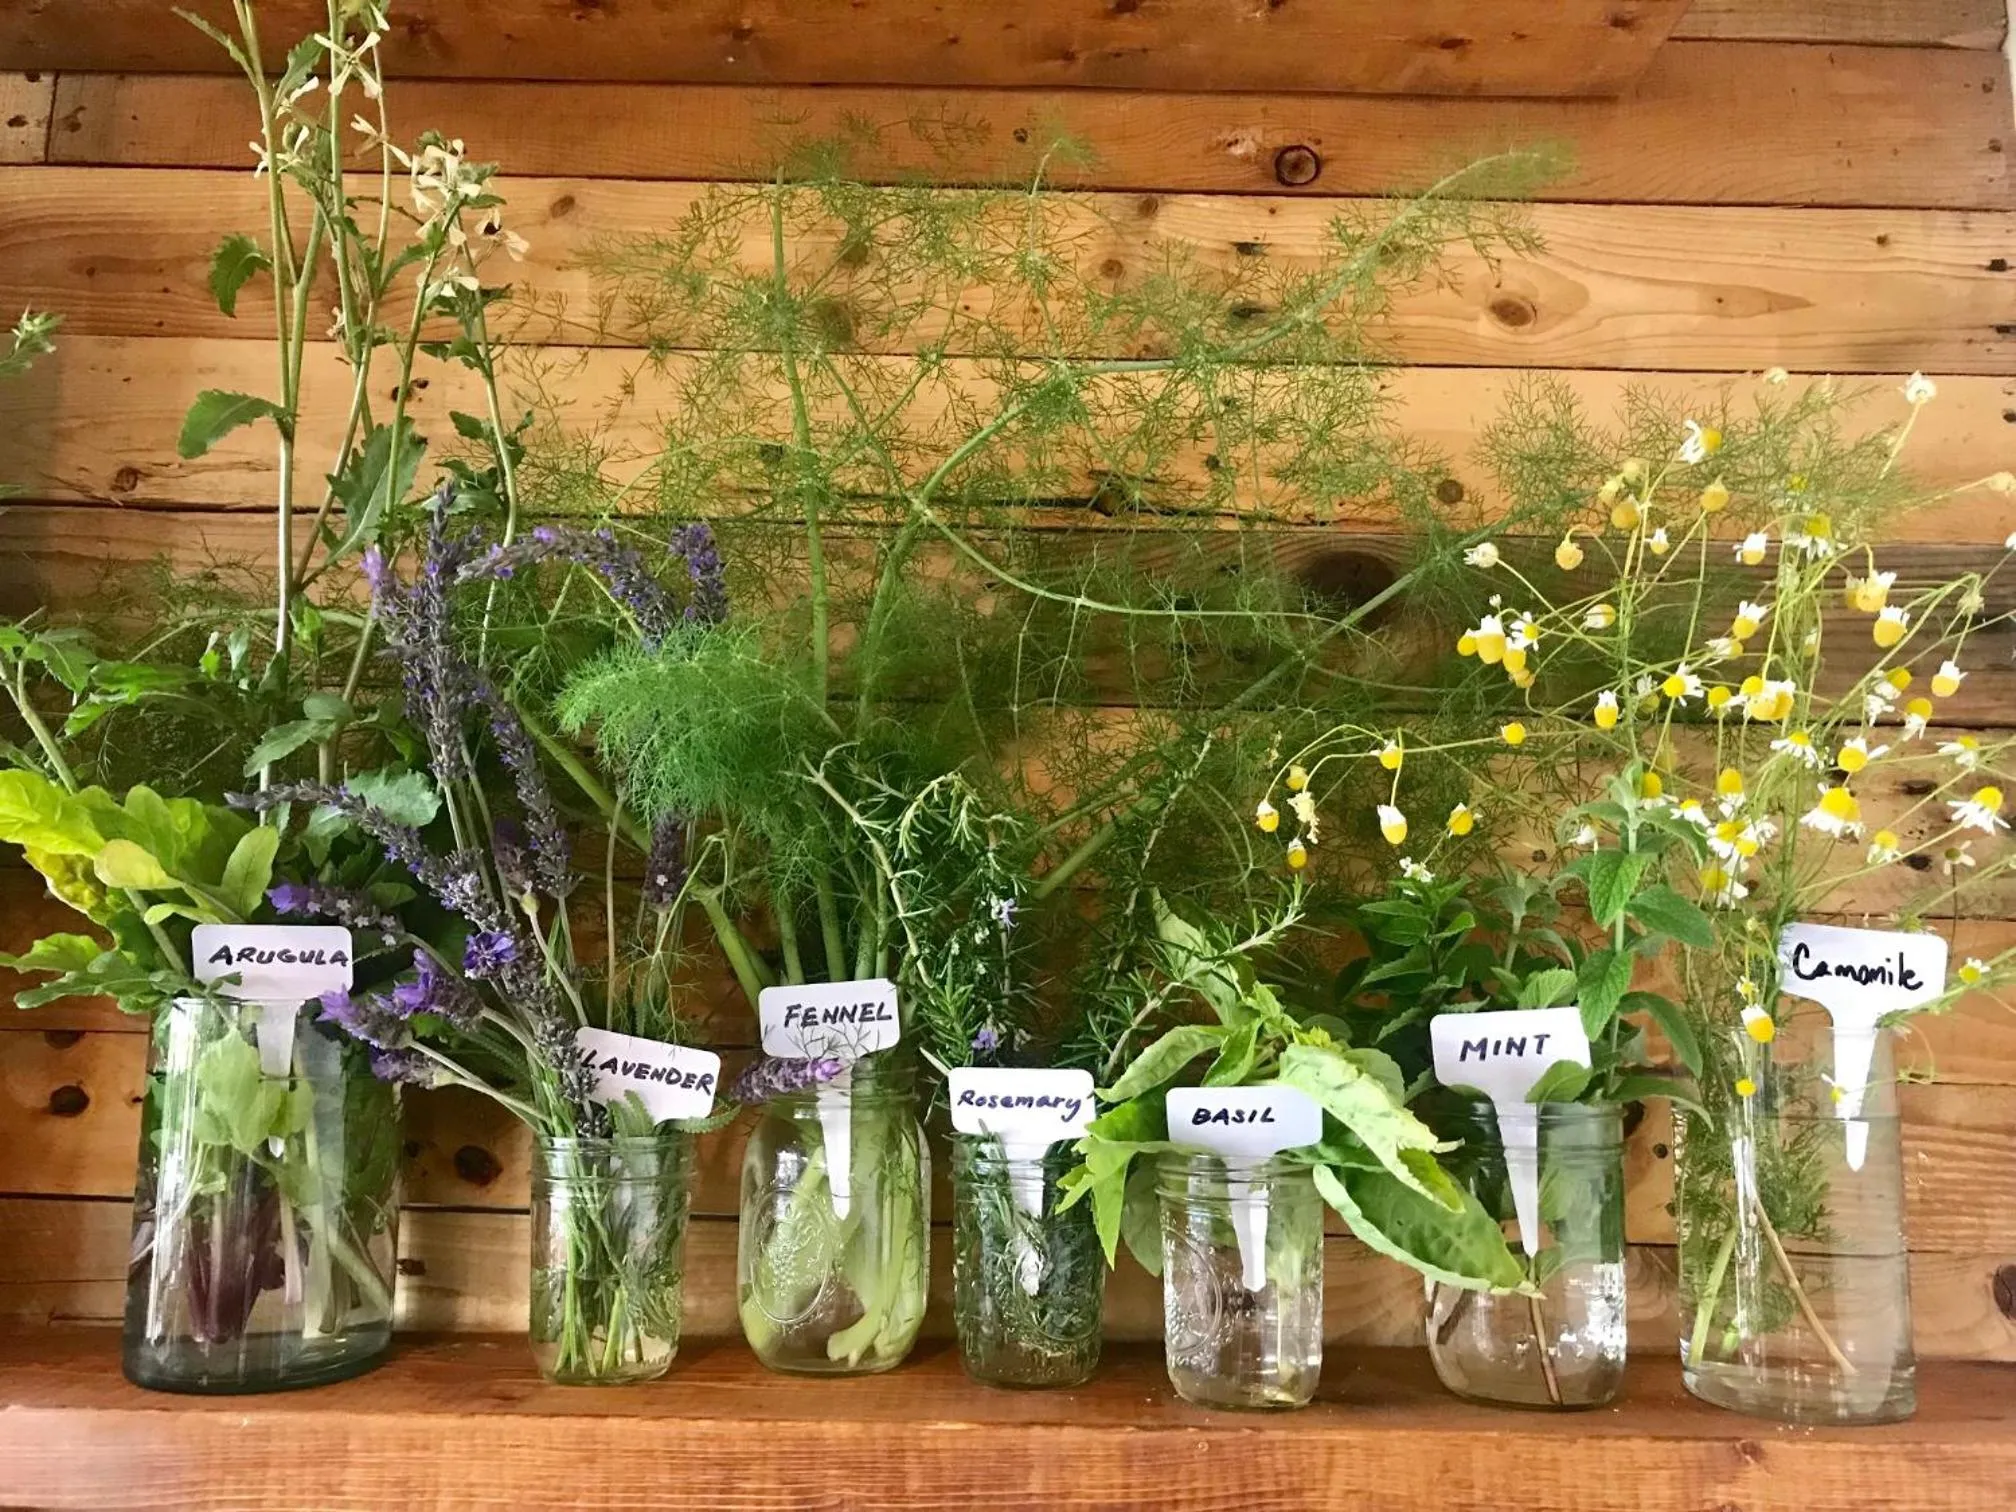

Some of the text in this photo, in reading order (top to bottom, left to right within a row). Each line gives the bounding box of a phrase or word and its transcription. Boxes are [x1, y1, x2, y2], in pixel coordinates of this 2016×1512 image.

[208, 944, 349, 967] ARUGULA
[784, 1001, 893, 1028] FENNEL
[1459, 1034, 1551, 1062] MINT
[580, 1049, 715, 1097] LAVENDER
[957, 1089, 1082, 1122] Rosemary
[1191, 1107, 1275, 1126] BASIL
